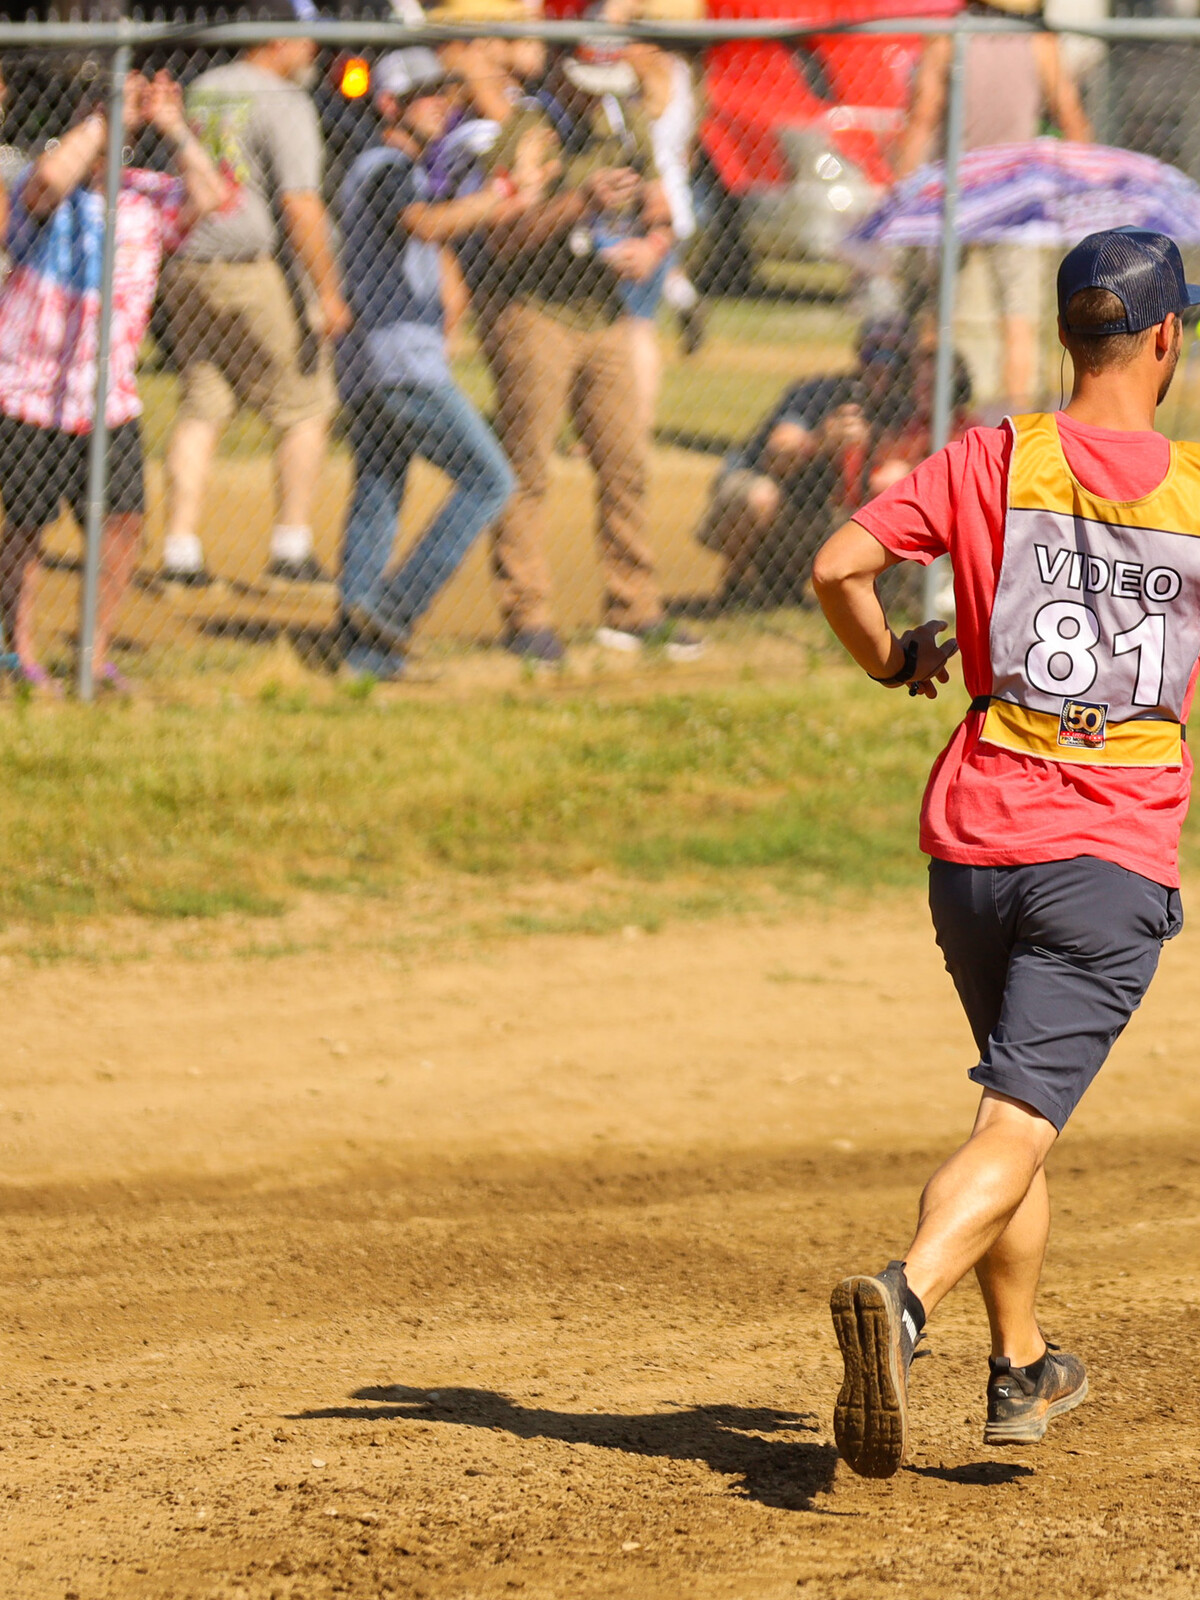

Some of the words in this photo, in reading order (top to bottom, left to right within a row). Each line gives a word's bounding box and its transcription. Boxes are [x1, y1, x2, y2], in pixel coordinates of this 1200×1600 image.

[1034, 544, 1182, 603] VIDEO
[1026, 600, 1166, 707] 81
[1067, 704, 1102, 732] 50
